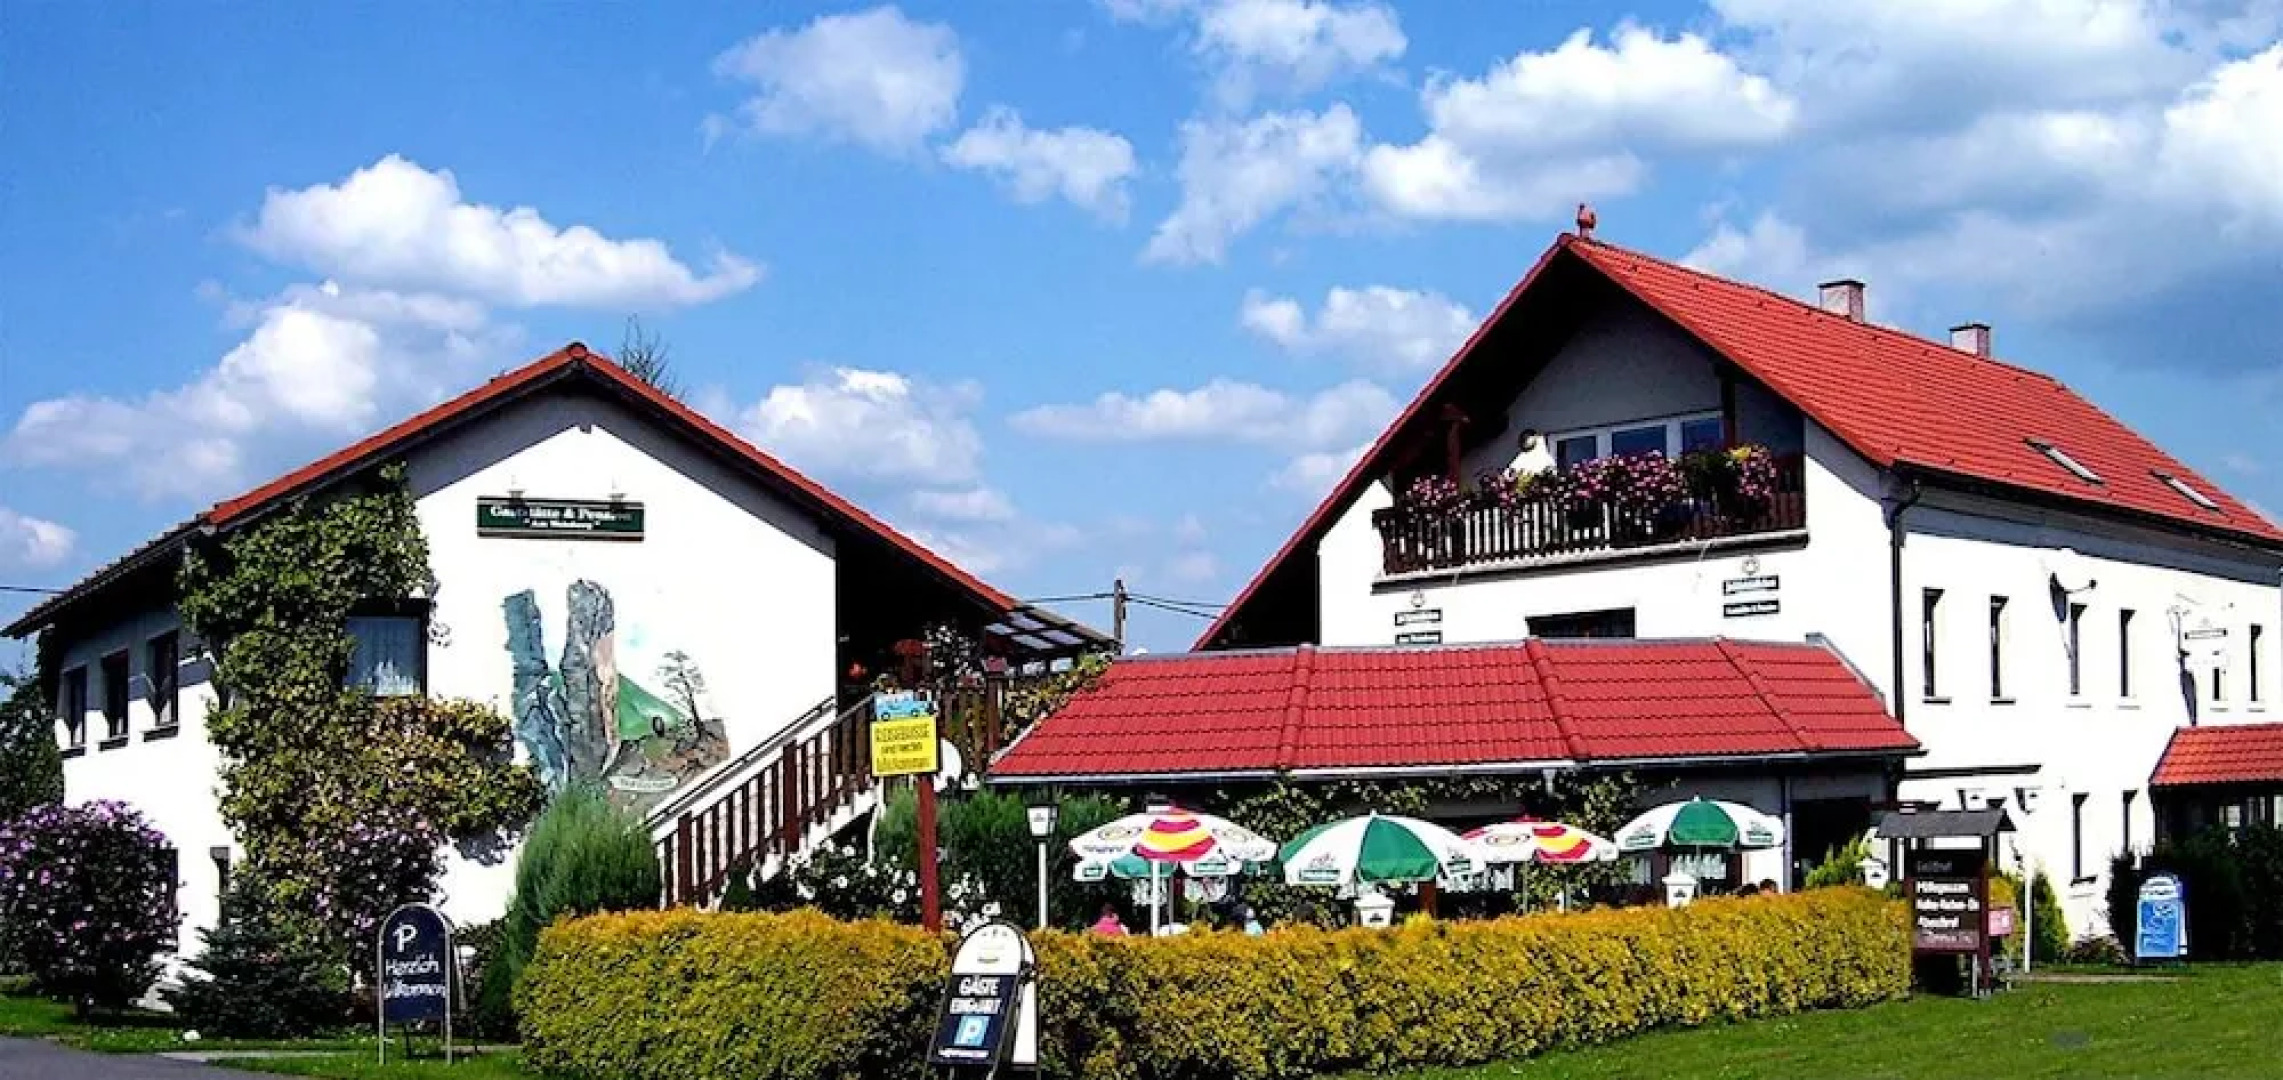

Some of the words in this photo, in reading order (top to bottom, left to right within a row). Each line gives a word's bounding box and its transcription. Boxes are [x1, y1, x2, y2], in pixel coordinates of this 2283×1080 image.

[393, 923, 418, 952] P
[959, 974, 1000, 996] GÄSTE
[958, 1017, 985, 1045] P
